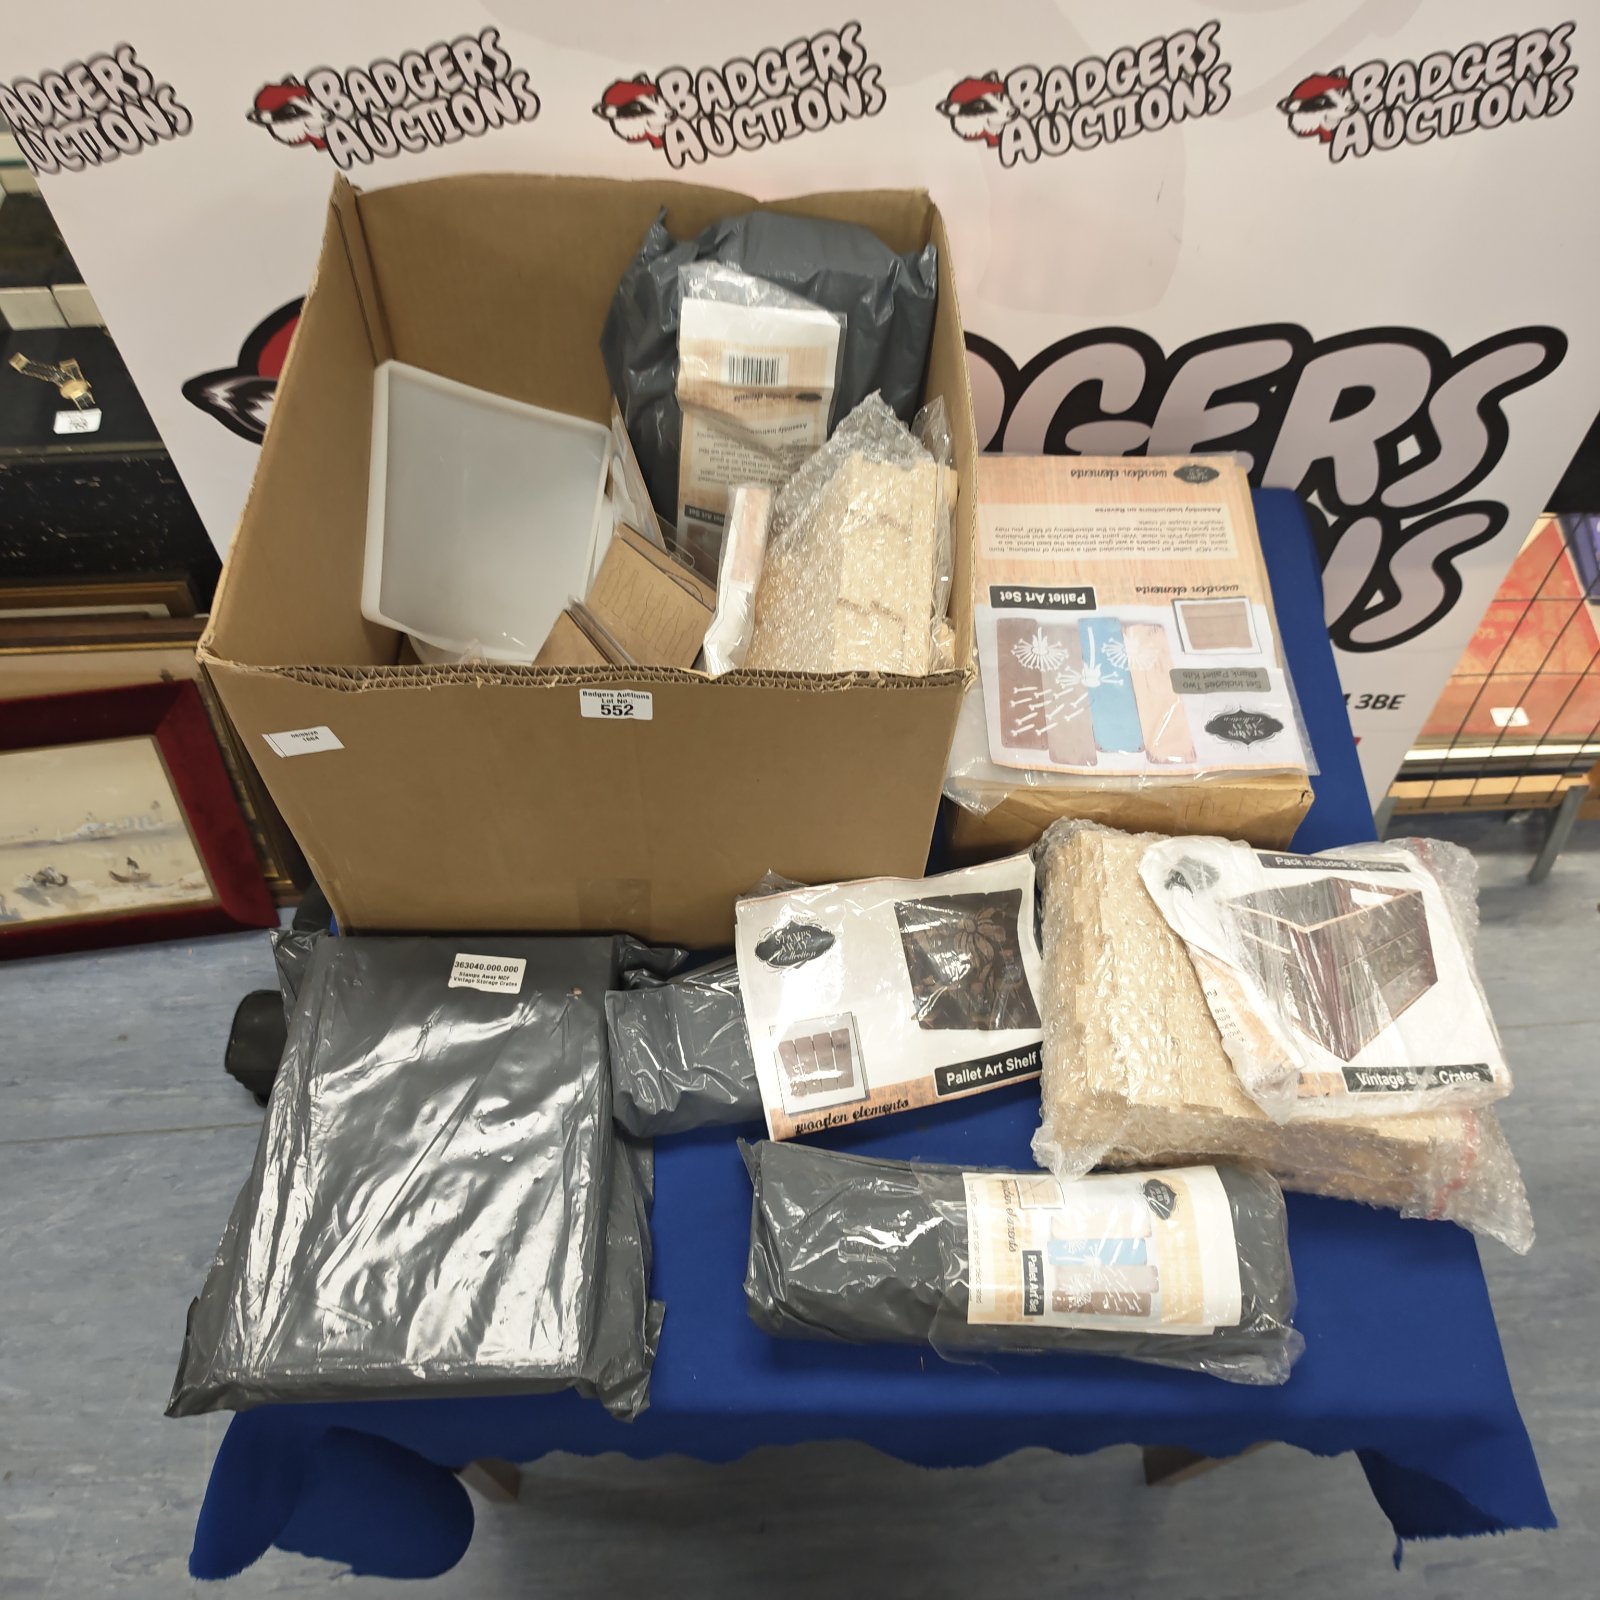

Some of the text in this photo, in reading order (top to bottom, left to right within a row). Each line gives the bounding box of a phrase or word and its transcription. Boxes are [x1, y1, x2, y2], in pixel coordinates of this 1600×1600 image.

[0, 42, 155, 131] ADGERS
[304, 25, 511, 122] BADGERS
[655, 20, 866, 121] BADGERS
[1004, 19, 1221, 120] BADGERS
[1349, 20, 1576, 114] BADGERS
[10, 82, 194, 176] UCTIONS
[325, 68, 541, 170] AUCTIONS
[664, 63, 886, 169] AUCTIONS
[998, 62, 1231, 168] AUCTIONS
[1329, 65, 1579, 163] AUCTIONS
[963, 323, 1568, 508] GERS
[1070, 469, 1167, 482] wooden elements
[1000, 591, 1086, 604] Pallet Art Set
[1135, 584, 1187, 596] elements
[1182, 682, 1201, 690] Two
[1354, 694, 1406, 710] 3BE
[601, 704, 634, 716] 552
[1275, 856, 1303, 866] Pack
[774, 931, 811, 945] STAMPS
[455, 960, 519, 973] 363040.000.000
[946, 1051, 1036, 1086] Pallet Art Shelf
[1355, 1071, 1405, 1090] Vintage
[1439, 1070, 1480, 1085] Crates
[794, 1099, 909, 1136] wooden elements
[1027, 1255, 1040, 1313] Pallet Art Set
